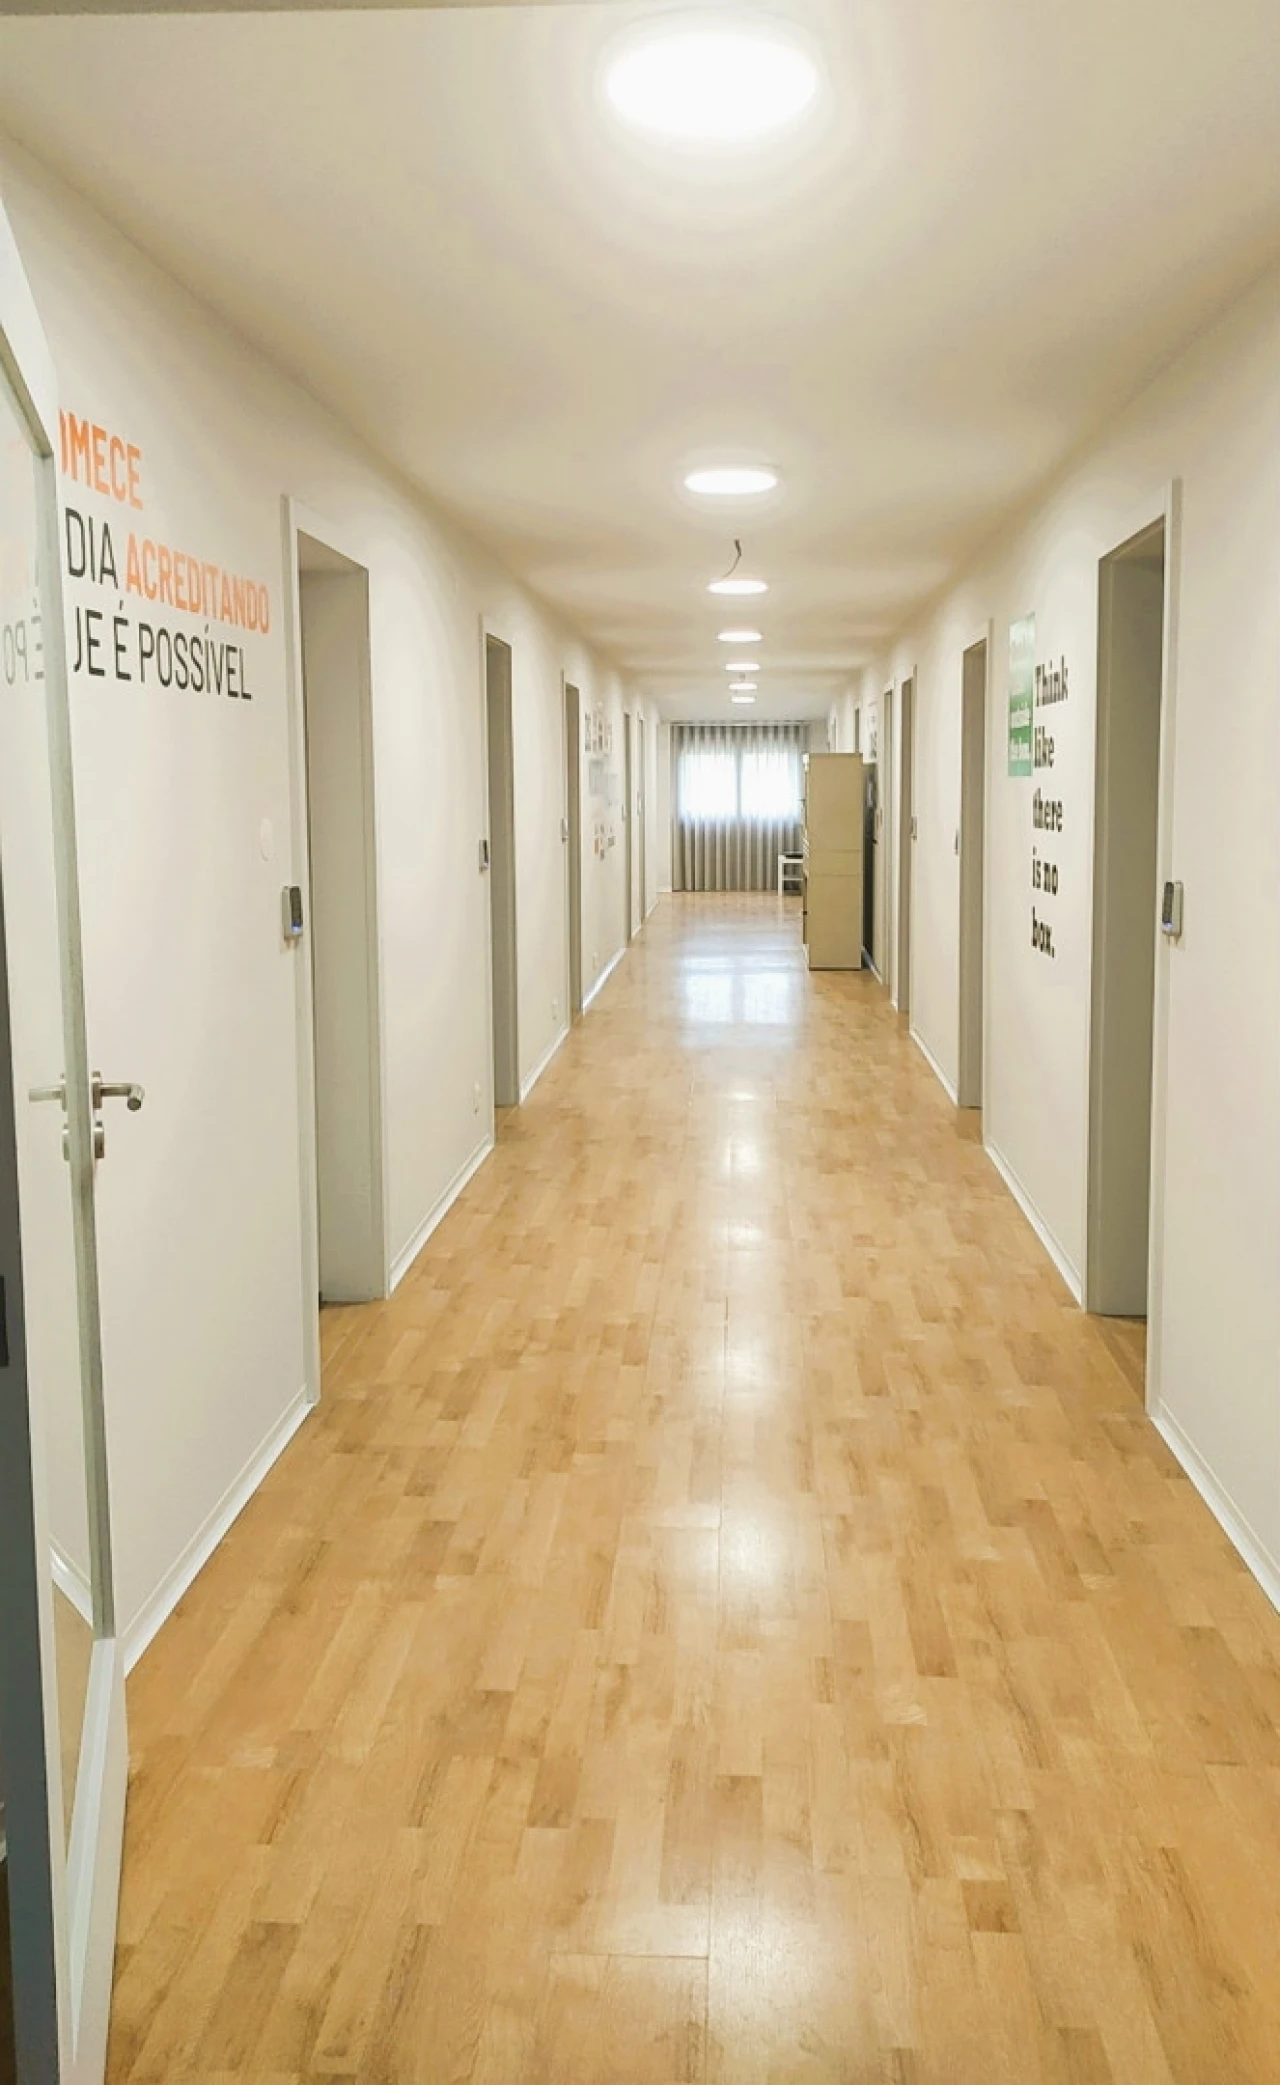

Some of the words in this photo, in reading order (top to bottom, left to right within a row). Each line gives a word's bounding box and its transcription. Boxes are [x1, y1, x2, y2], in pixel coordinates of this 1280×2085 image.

[65, 507, 119, 590] DIA
[126, 532, 271, 635] ACREDITANDO
[112, 599, 132, 682] É
[138, 622, 252, 701] POSSÍVEL
[1034, 655, 1069, 708] Think
[1033, 726, 1055, 769] like
[1032, 787, 1063, 833] there
[1032, 846, 1042, 889] is
[1043, 861, 1059, 896] no
[1031, 905, 1055, 958] box.
